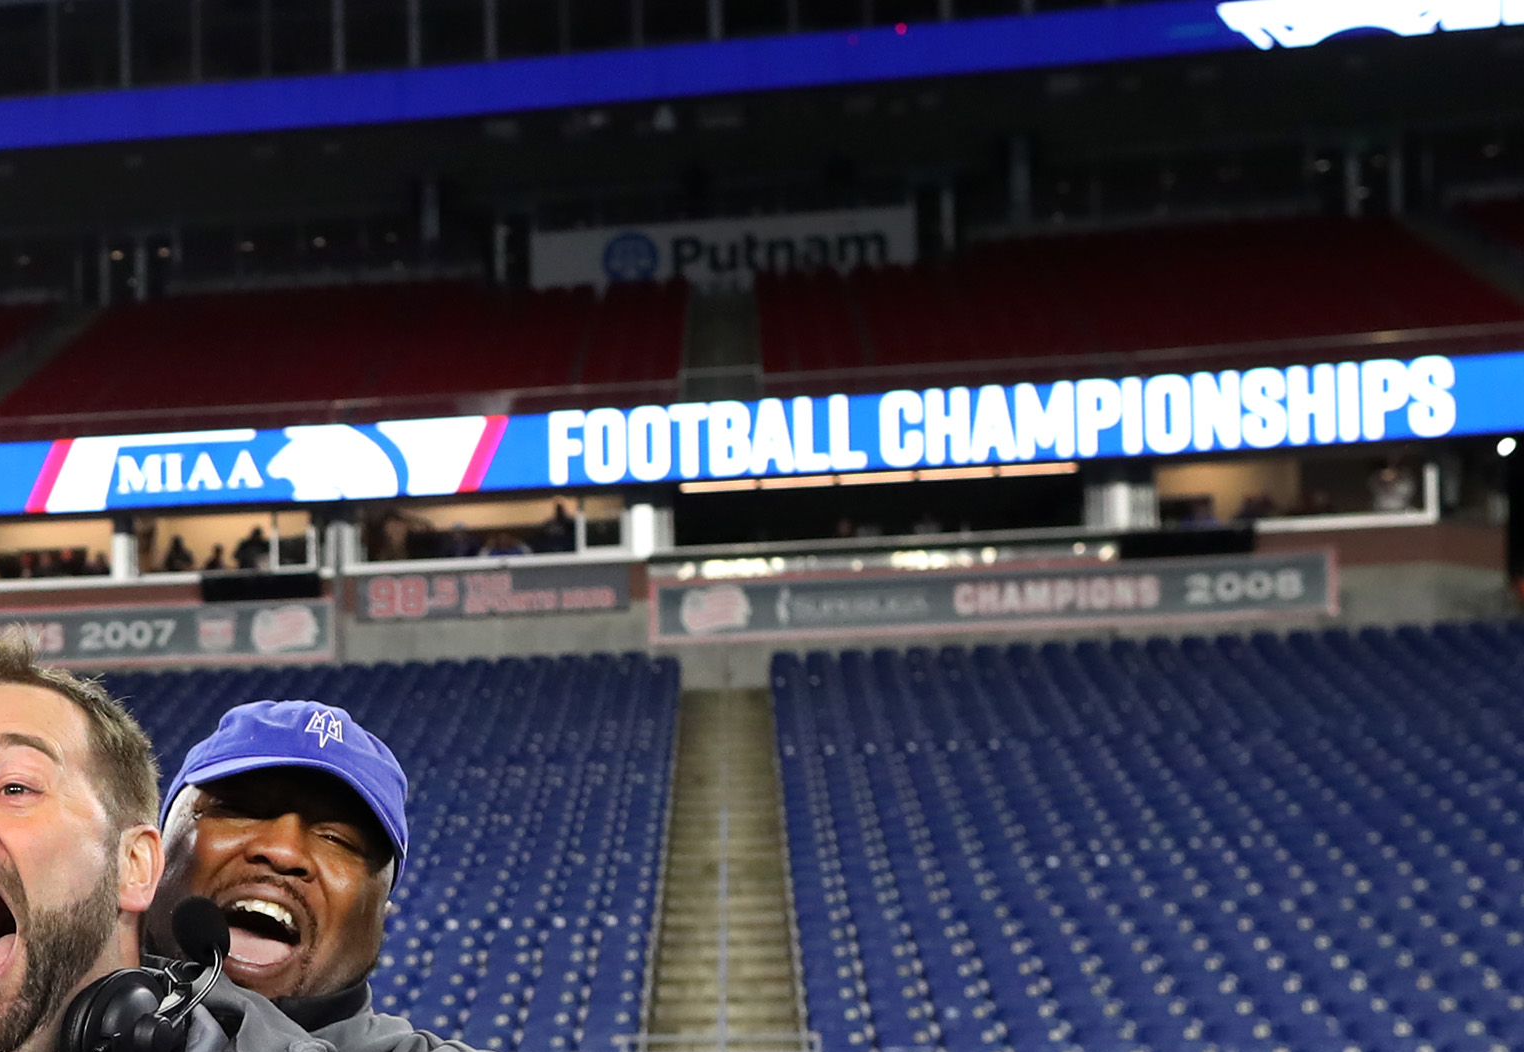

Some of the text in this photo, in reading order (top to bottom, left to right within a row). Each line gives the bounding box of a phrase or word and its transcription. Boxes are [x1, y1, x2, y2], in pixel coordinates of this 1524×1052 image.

[672, 230, 887, 275] Putnam
[548, 355, 1457, 485] FOOTBALL CHAMPIONSHIPS
[117, 450, 264, 494] MIAA
[953, 574, 1161, 618] CHAMPIONS
[78, 618, 177, 651] 2007
